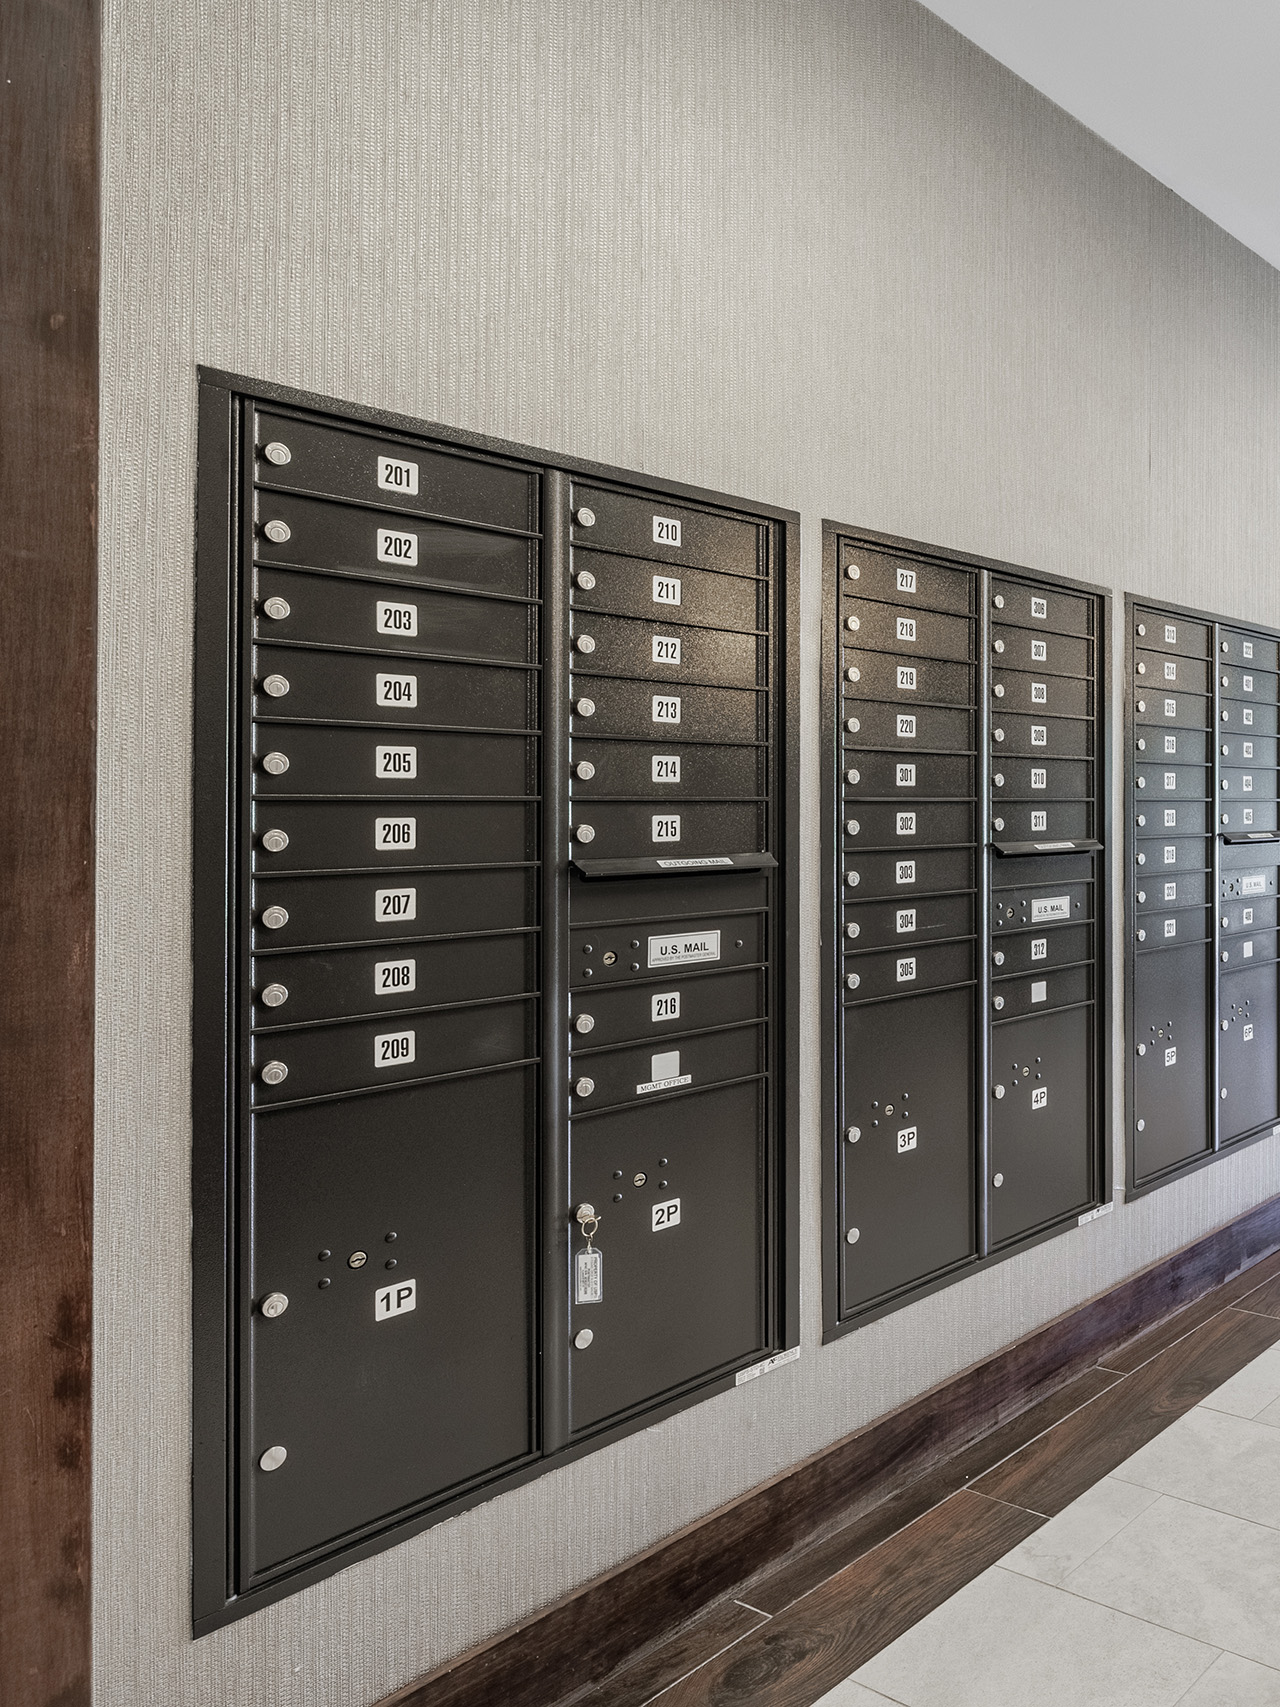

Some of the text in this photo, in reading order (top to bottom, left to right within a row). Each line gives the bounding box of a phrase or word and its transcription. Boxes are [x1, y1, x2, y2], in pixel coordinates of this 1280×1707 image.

[384, 463, 410, 488] 201
[657, 521, 677, 542] 210
[384, 536, 412, 559] 202
[899, 573, 914, 588] 217
[657, 581, 676, 600] 211
[384, 608, 412, 631] 203
[899, 621, 914, 637] 218
[657, 641, 677, 660] 212
[1033, 644, 1045, 657] 307
[900, 670, 914, 686] 219
[383, 680, 412, 702] 204
[657, 700, 677, 719] 213
[900, 719, 914, 734] 220
[383, 752, 411, 773] 205
[657, 760, 677, 778] 214
[899, 768, 912, 782] 301
[1033, 772, 1044, 785] 310
[657, 820, 677, 837] 215
[899, 816, 914, 831] 302
[1033, 815, 1044, 828] 311
[382, 823, 411, 844] 206
[664, 860, 707, 868] OUTGOING
[899, 864, 913, 880] 303
[382, 894, 411, 916] 207
[1038, 905, 1049, 914] U.S.
[1050, 904, 1064, 912] MAIL
[899, 913, 914, 929] 304
[660, 941, 709, 956] U.S. MAIL
[1033, 942, 1045, 956] 312
[382, 965, 410, 988] 208
[899, 961, 914, 977] 305
[656, 997, 676, 1017] 216
[381, 1037, 409, 1061] 209
[1166, 1050, 1176, 1063] 5P
[641, 1077, 689, 1092] MGMT OFFICE
[1033, 1091, 1046, 1105] 4P
[899, 1131, 916, 1148] 3P
[655, 1204, 678, 1226] 2P
[380, 1286, 413, 1312] 1P
